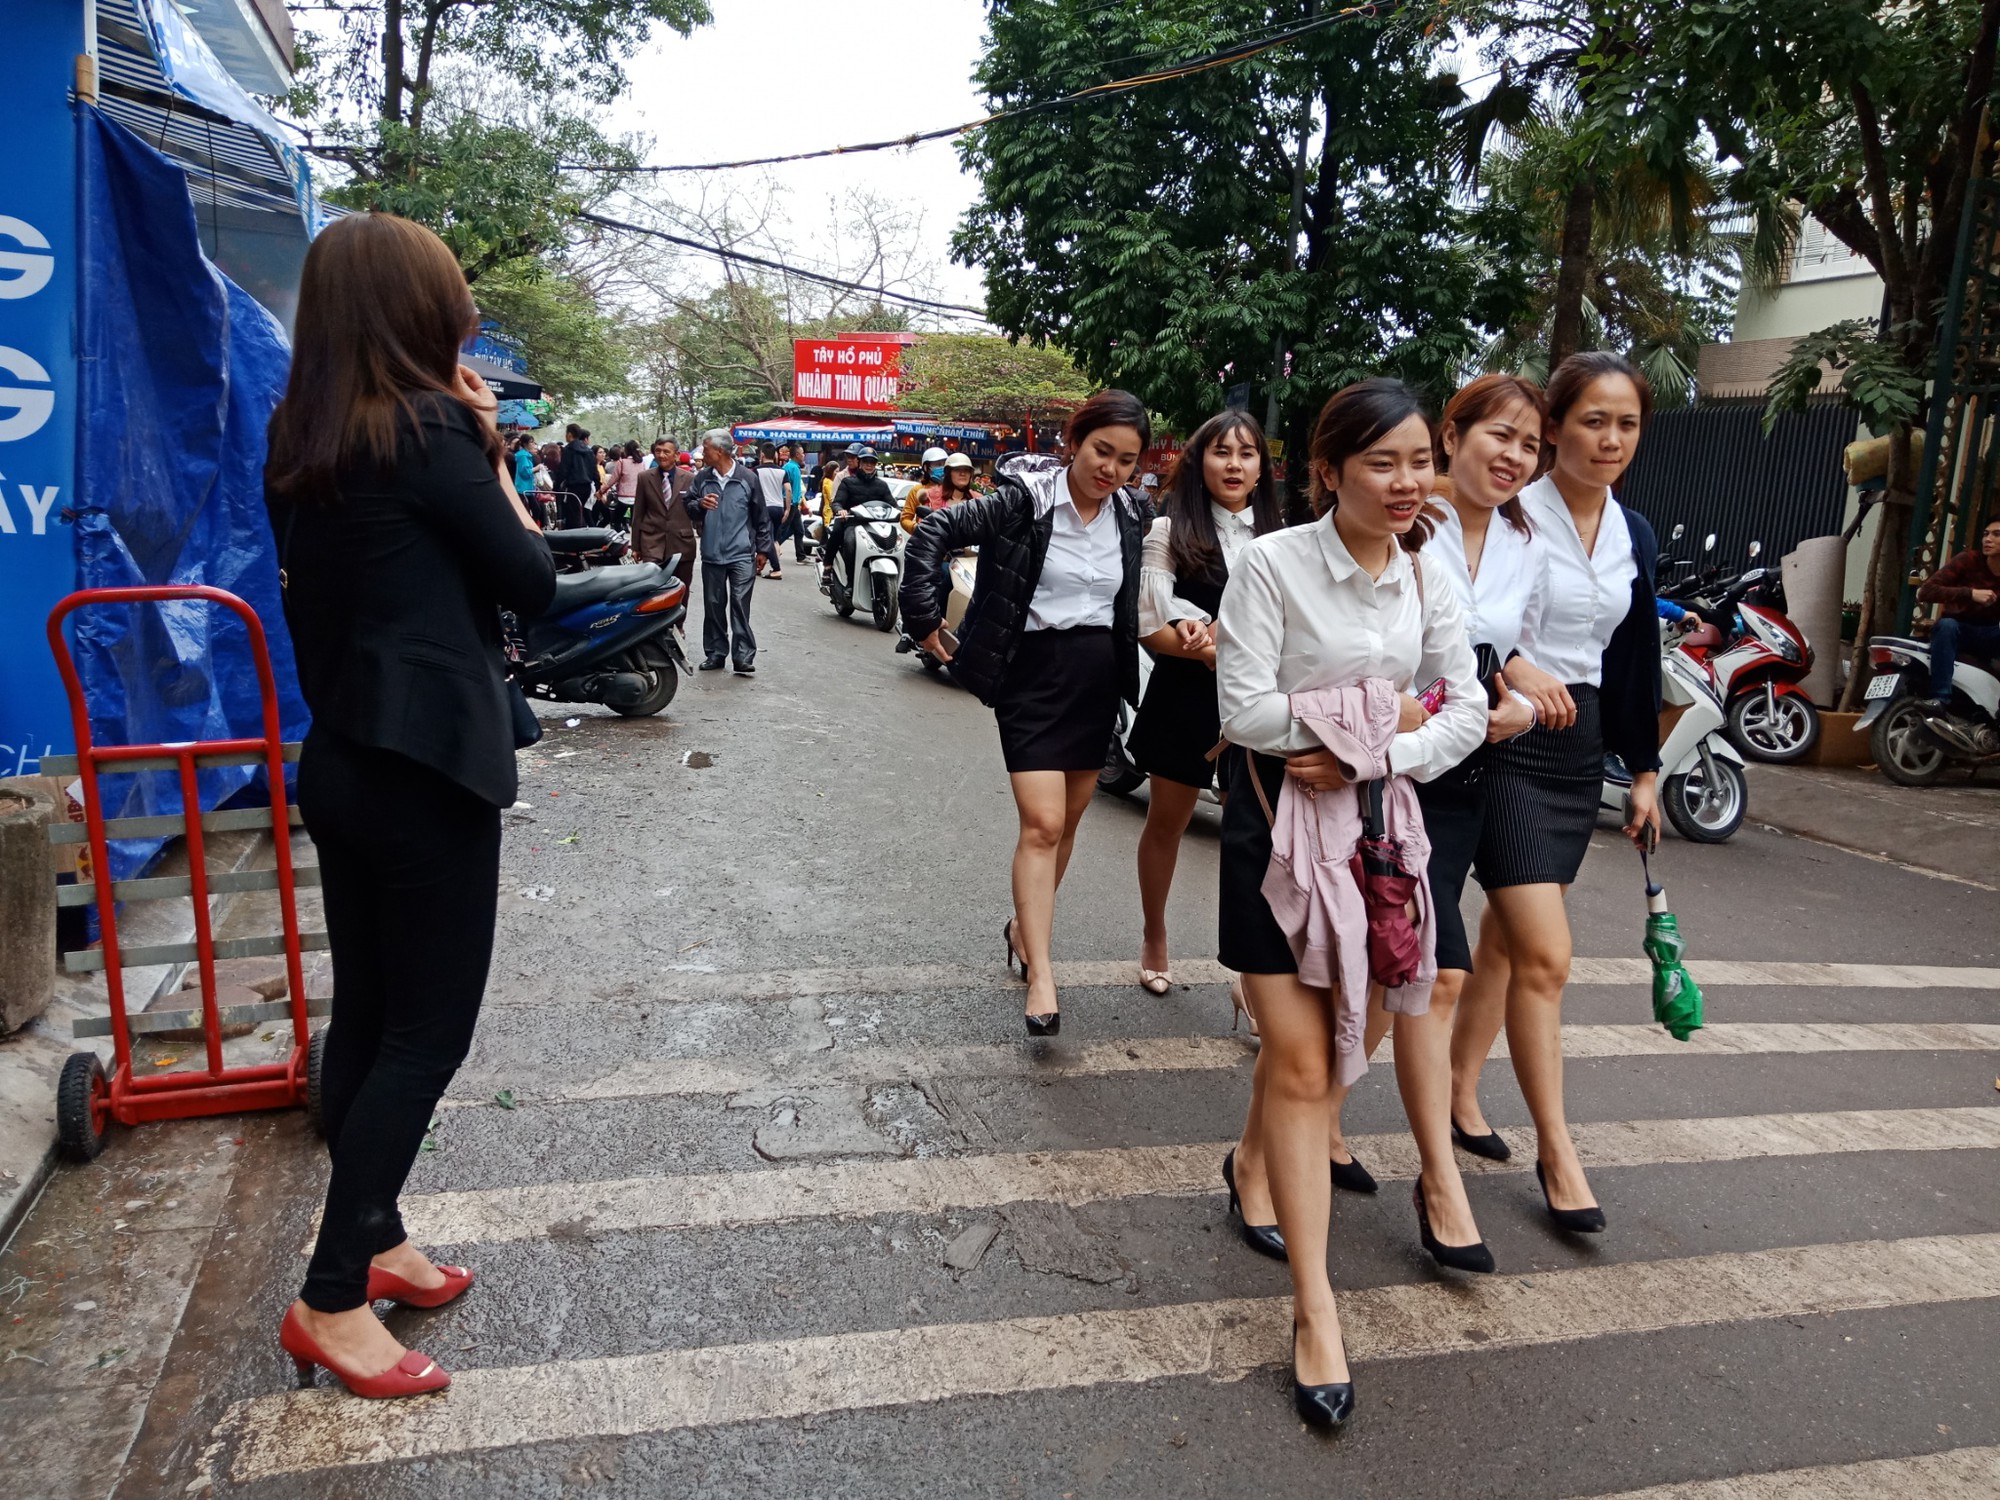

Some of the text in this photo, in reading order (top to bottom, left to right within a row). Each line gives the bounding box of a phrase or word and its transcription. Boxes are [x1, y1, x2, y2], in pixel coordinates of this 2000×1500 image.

[813, 345, 882, 365] TÂY HỒ PHỦ
[798, 368, 832, 399] NHÂM
[835, 369, 861, 401] THÌN
